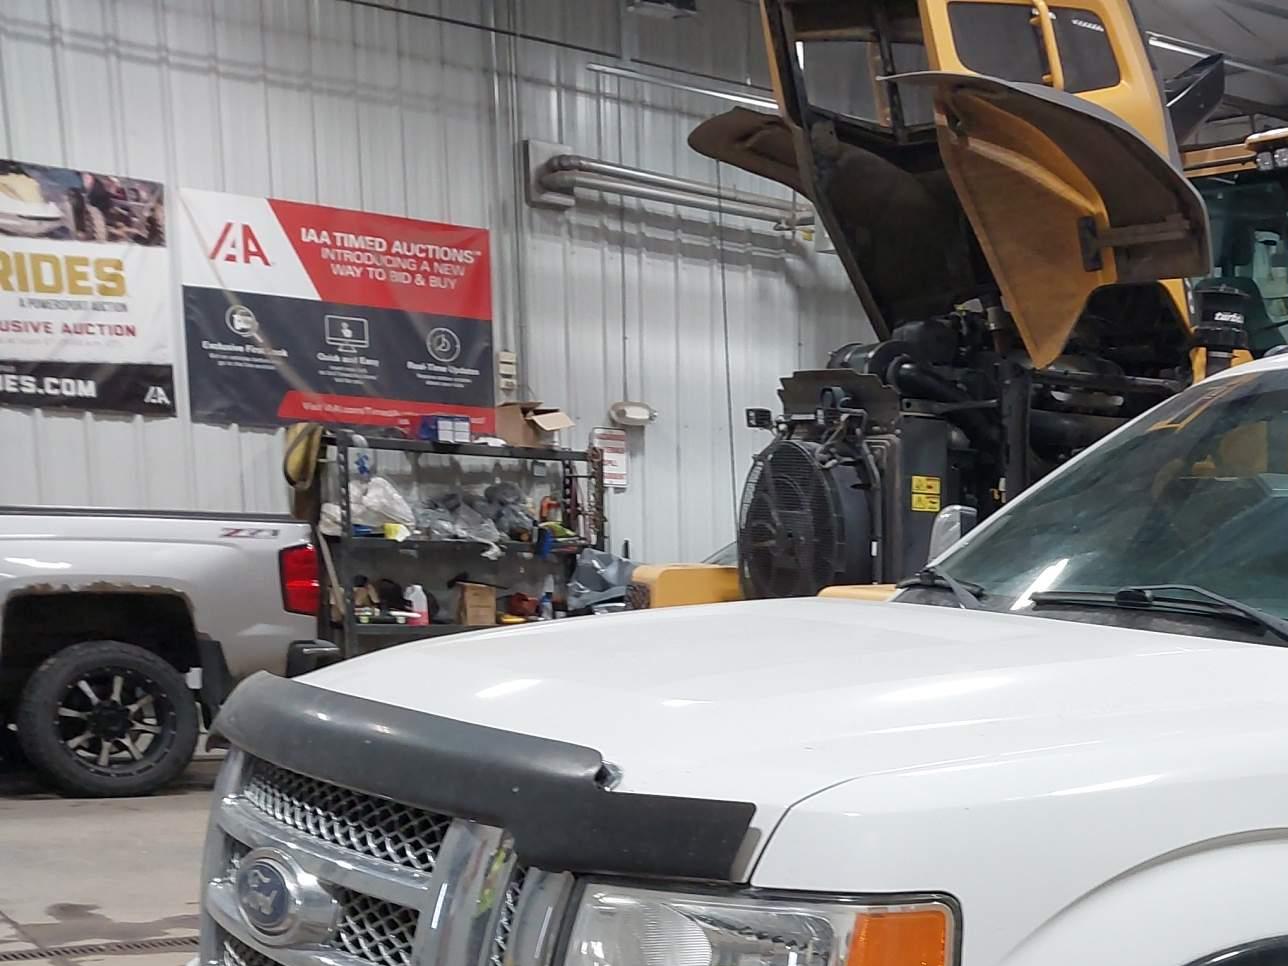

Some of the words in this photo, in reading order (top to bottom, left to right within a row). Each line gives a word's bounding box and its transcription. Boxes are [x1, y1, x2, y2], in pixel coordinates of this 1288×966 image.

[300, 227, 332, 245] IAA
[333, 232, 386, 252] TIMED
[321, 248, 417, 271] INTRODUCING
[420, 261, 431, 273] A
[433, 263, 465, 277] NEW
[331, 263, 363, 278] WAY
[366, 267, 386, 281] TO
[389, 271, 412, 284] BID
[414, 274, 426, 287] &
[429, 276, 458, 290] BUY
[61, 322, 136, 337] AUCTION
[0, 374, 97, 398] ES.COM
